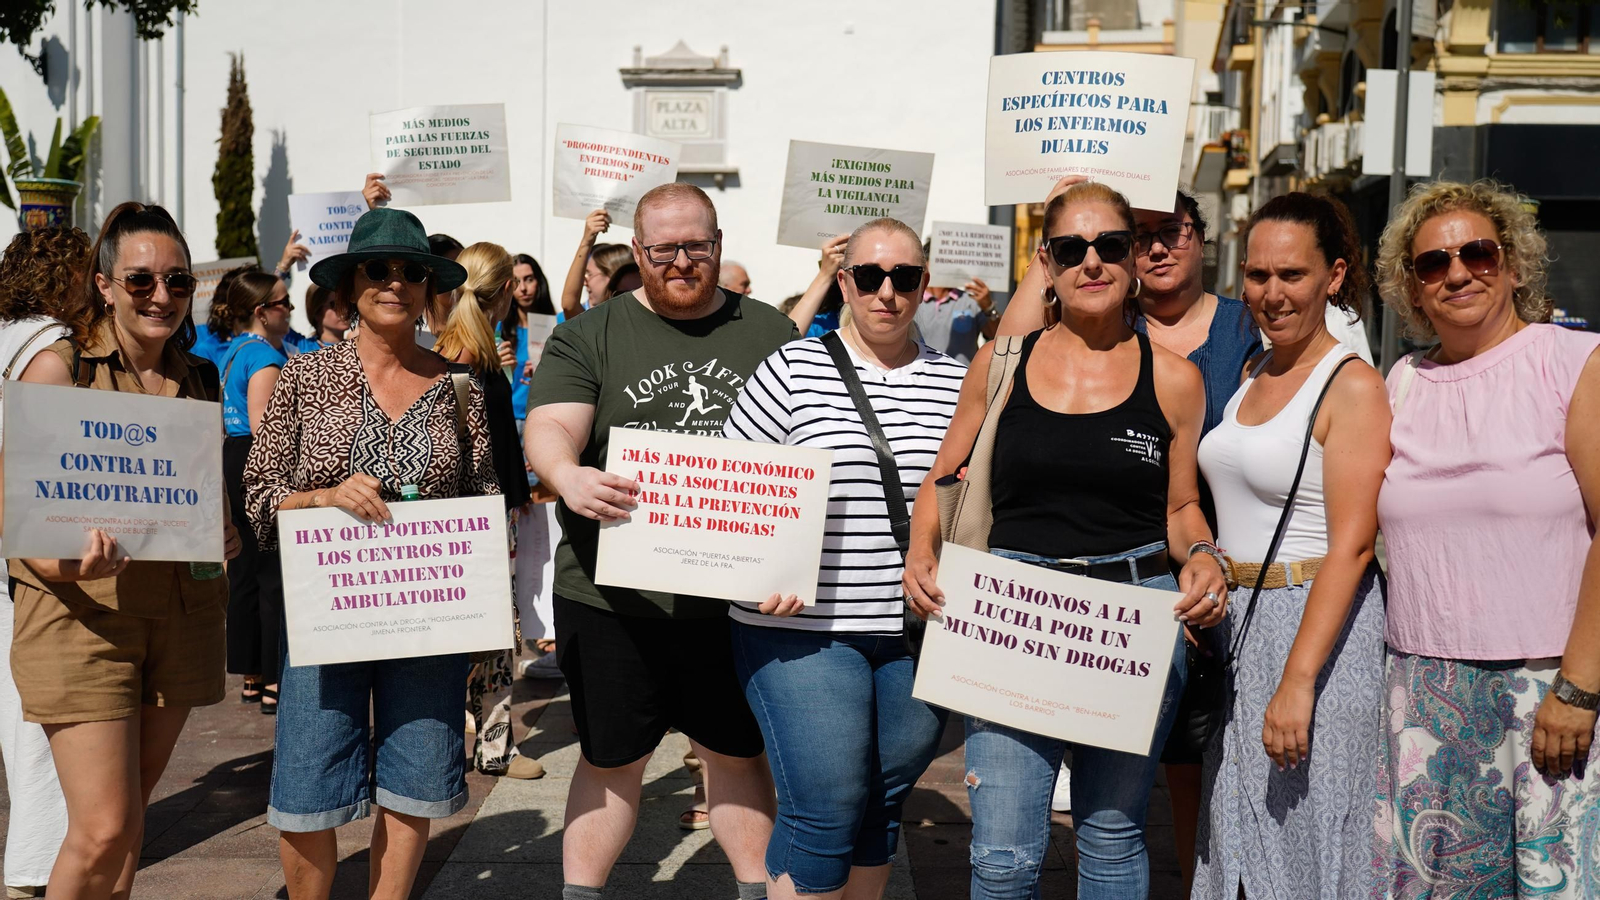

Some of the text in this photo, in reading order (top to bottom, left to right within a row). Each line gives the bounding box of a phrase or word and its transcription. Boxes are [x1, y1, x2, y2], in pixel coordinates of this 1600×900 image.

[1041, 70, 1126, 87] CENTROS
[656, 101, 703, 114] PLAZA
[1001, 90, 1169, 115] ESPECÍFICOS PARA
[402, 117, 470, 130] MÁS MEDIOS
[661, 118, 698, 130] ALTA
[1014, 116, 1148, 136] LOS ENFERMOS
[385, 130, 490, 145] PARA LAS FUERZAS
[386, 144, 492, 159] DE SEGURIDAD DEL
[562, 139, 671, 166] “DROGODEPENDIENTES
[1041, 138, 1109, 155] DUALES
[418, 159, 462, 171] ESTADO
[579, 154, 645, 173] ENFERMOS DE
[831, 158, 892, 174] ¡EXIGIMOS
[584, 167, 634, 182] PRIMERA”
[810, 170, 915, 190] MÁS MEDIOS PARA
[1005, 167, 1039, 177] ASOCIACIÓN
[1080, 166, 1089, 174] DE
[1090, 167, 1125, 178] ENFERMOS
[1126, 171, 1151, 181] DUALES
[817, 187, 900, 204] LA VIGILANCIA
[326, 204, 362, 216] TOD@S
[823, 203, 890, 218] ADUANERA!
[319, 220, 357, 231] CONTR
[308, 234, 351, 246] NARCOT
[976, 241, 993, 249] PARA
[934, 257, 1005, 268] DROGODEPENDIENTES
[994, 251, 1003, 259] DE
[623, 363, 678, 409] LOOK
[657, 381, 735, 405] YOUR PHYSI
[668, 401, 686, 409] AND
[691, 419, 724, 427] MENTAL
[80, 419, 158, 447] TOD@S
[1110, 437, 1146, 445] COORDINADORA
[1132, 448, 1147, 456] DROGA
[60, 452, 177, 477] CONTRA EL
[622, 447, 815, 482] ¡MÁS APOYO ECONÓMICO
[35, 480, 199, 506] NARCOTRAFICO
[634, 470, 799, 500] A LAS ASOCIACIONES
[674, 494, 694, 509] LA
[698, 496, 802, 520] PREVENCIÓN
[45, 515, 92, 524] ASOCIACIÓN
[93, 516, 123, 525] CONTRA
[123, 518, 133, 526] LA
[133, 518, 159, 527] DROGA
[648, 511, 776, 538] DE LAS DROGAS!
[98, 526, 121, 534] PABLO
[122, 527, 132, 535] DE
[132, 527, 158, 535] BUCEITE
[295, 516, 491, 545] HAY QUE POTENCIAR
[317, 540, 473, 566] LOS CENTROS DE
[653, 546, 698, 557] ASOCIACIÓN
[680, 557, 735, 570] JEREZ DE LA FRA.
[328, 563, 465, 588] TRATAMIENTO
[330, 586, 467, 611] AMBULATORIO
[973, 572, 1142, 625] UNÁMONOS A LA
[313, 621, 358, 632] ASOCIACIÓN
[359, 619, 389, 629] CONTRA
[389, 618, 398, 627] LA
[399, 617, 427, 626] DROGA
[370, 625, 432, 637] JIMENA FRONTERA
[973, 598, 1132, 649] LUCHA POR UN
[943, 615, 1151, 678] MUNDO SIN DROGAS
[950, 673, 998, 694] ASOCIACIÓN
[998, 687, 1030, 702] CONTRA
[1030, 695, 1041, 705] LA
[1041, 698, 1071, 712] DROGA
[1008, 700, 1056, 717] LOS BARRIOS
